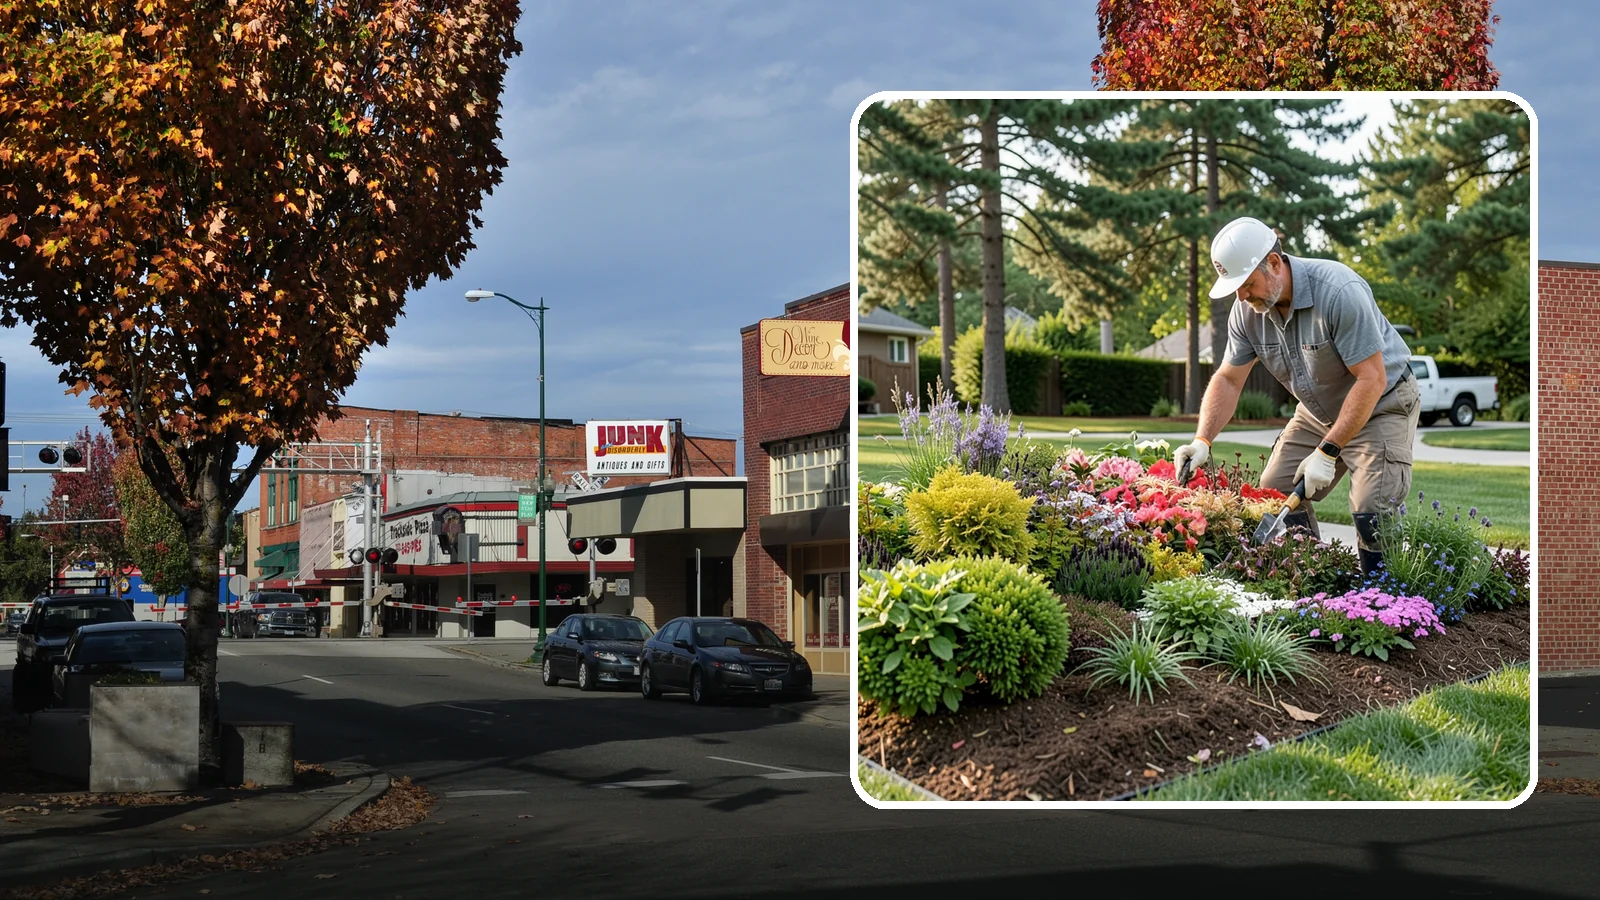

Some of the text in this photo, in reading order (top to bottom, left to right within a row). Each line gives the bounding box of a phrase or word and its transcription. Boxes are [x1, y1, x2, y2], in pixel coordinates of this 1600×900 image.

[765, 328, 831, 365] Decor
[595, 425, 665, 457] JUNK
[607, 446, 645, 454] DISORDERLY
[597, 460, 665, 470] ANTIQUES AND GIFTS
[390, 520, 428, 539] Trackside Pizza
